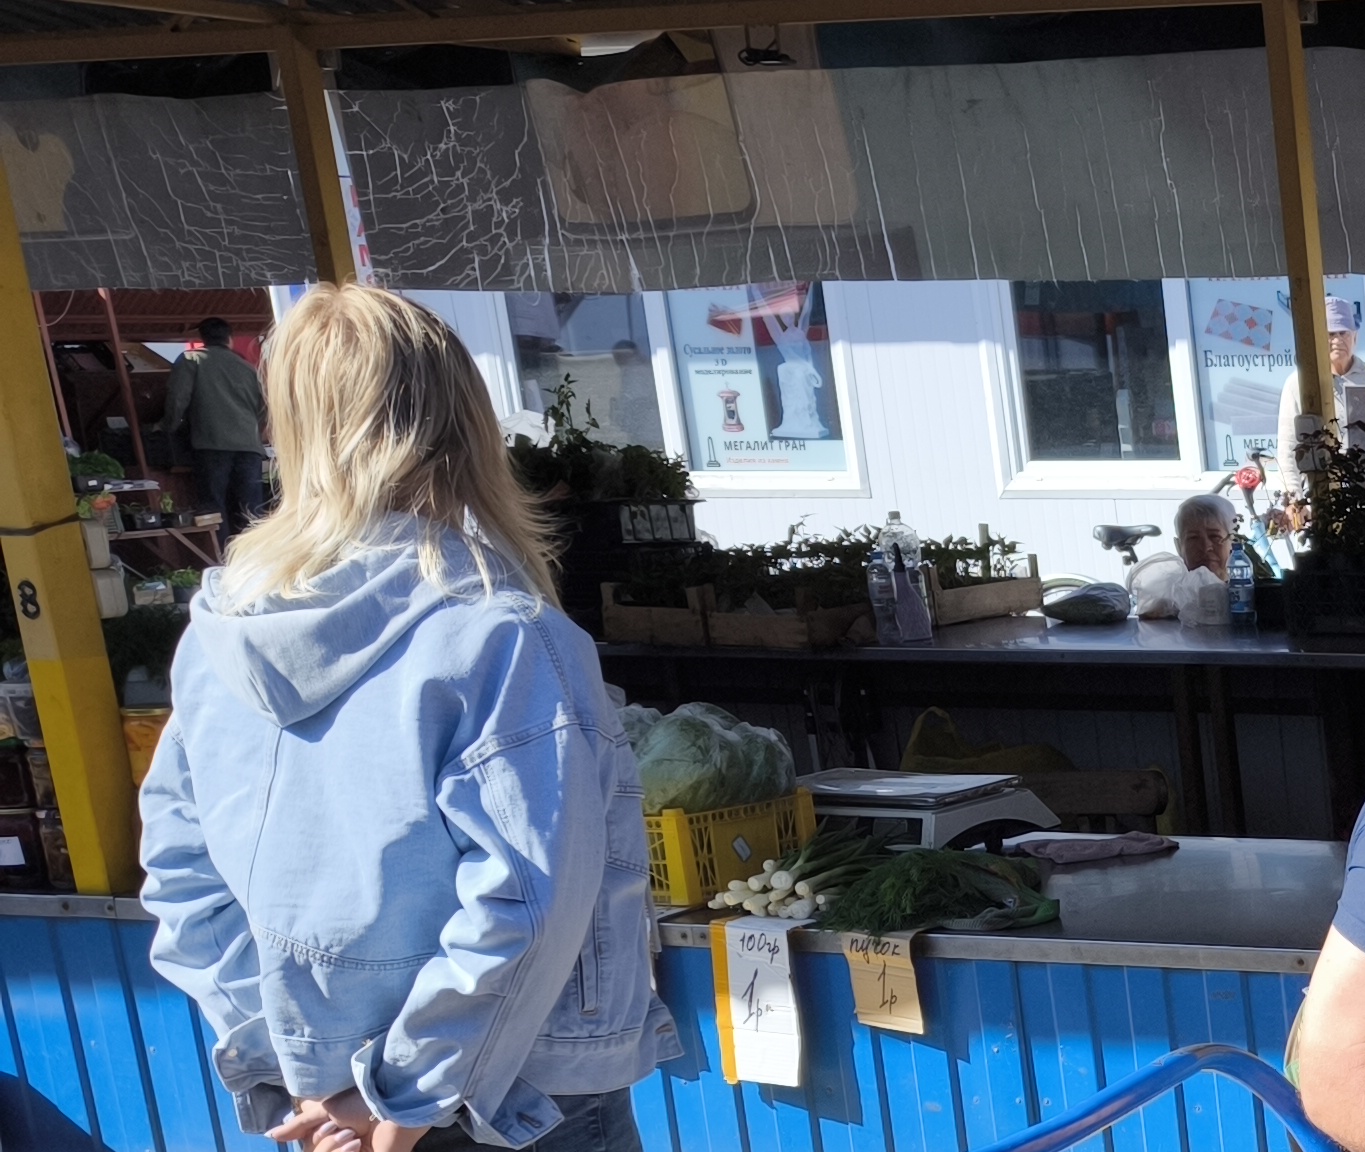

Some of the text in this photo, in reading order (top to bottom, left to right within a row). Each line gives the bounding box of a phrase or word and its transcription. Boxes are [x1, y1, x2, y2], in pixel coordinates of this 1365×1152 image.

[724, 440, 806, 451] МЕГАЛИТ ГРАН
[17, 579, 41, 620] 8
[850, 935, 900, 965] пучок
